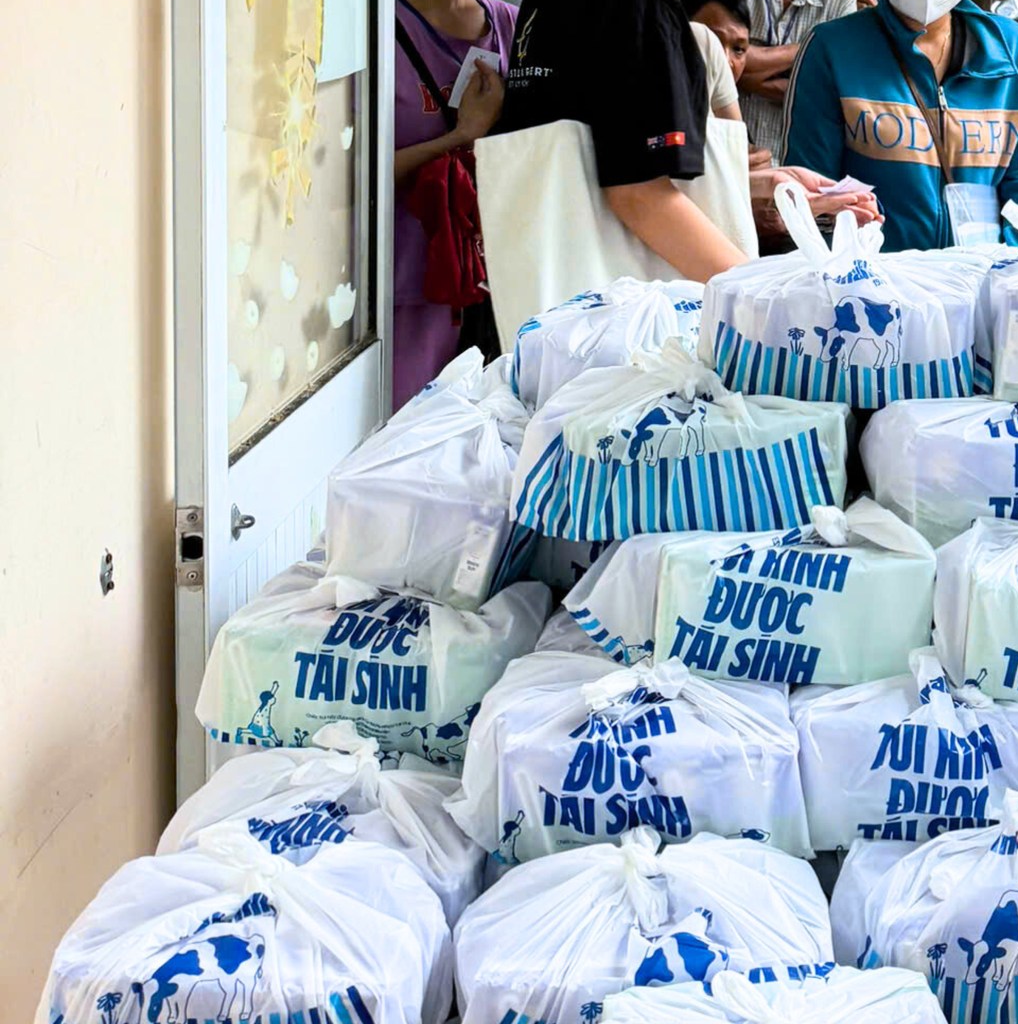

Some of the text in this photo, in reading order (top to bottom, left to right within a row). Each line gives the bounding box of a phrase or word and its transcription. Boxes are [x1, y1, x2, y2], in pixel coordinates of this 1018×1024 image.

[703, 575, 813, 637] ĐƯỢC
[294, 649, 428, 712] TÁI SINH
[669, 615, 821, 685] TÁI SINH
[539, 785, 596, 836] TÁI
